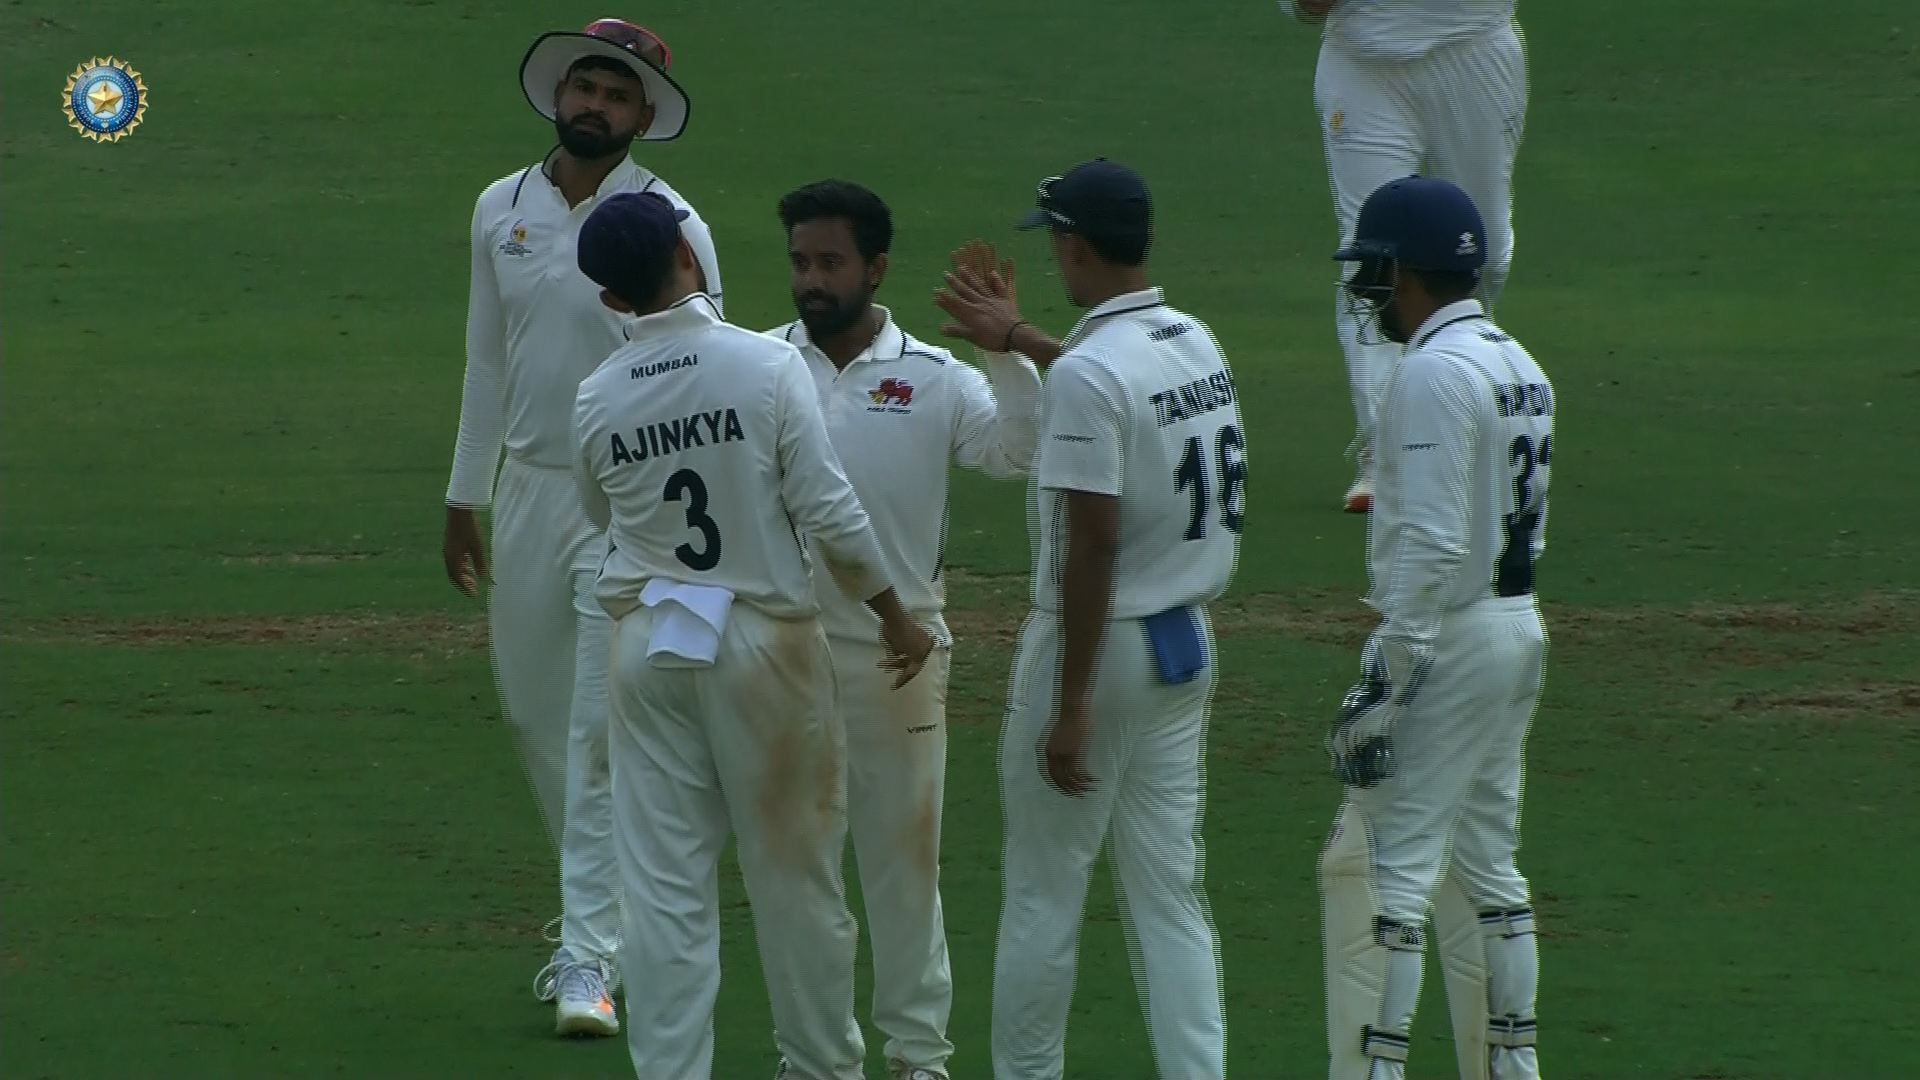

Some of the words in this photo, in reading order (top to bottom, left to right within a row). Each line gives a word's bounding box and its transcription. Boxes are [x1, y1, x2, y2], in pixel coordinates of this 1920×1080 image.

[631, 353, 698, 380] MUMBAI
[610, 408, 745, 466] AJINKYA
[662, 468, 722, 571] 3
[1172, 424, 1248, 541] 16
